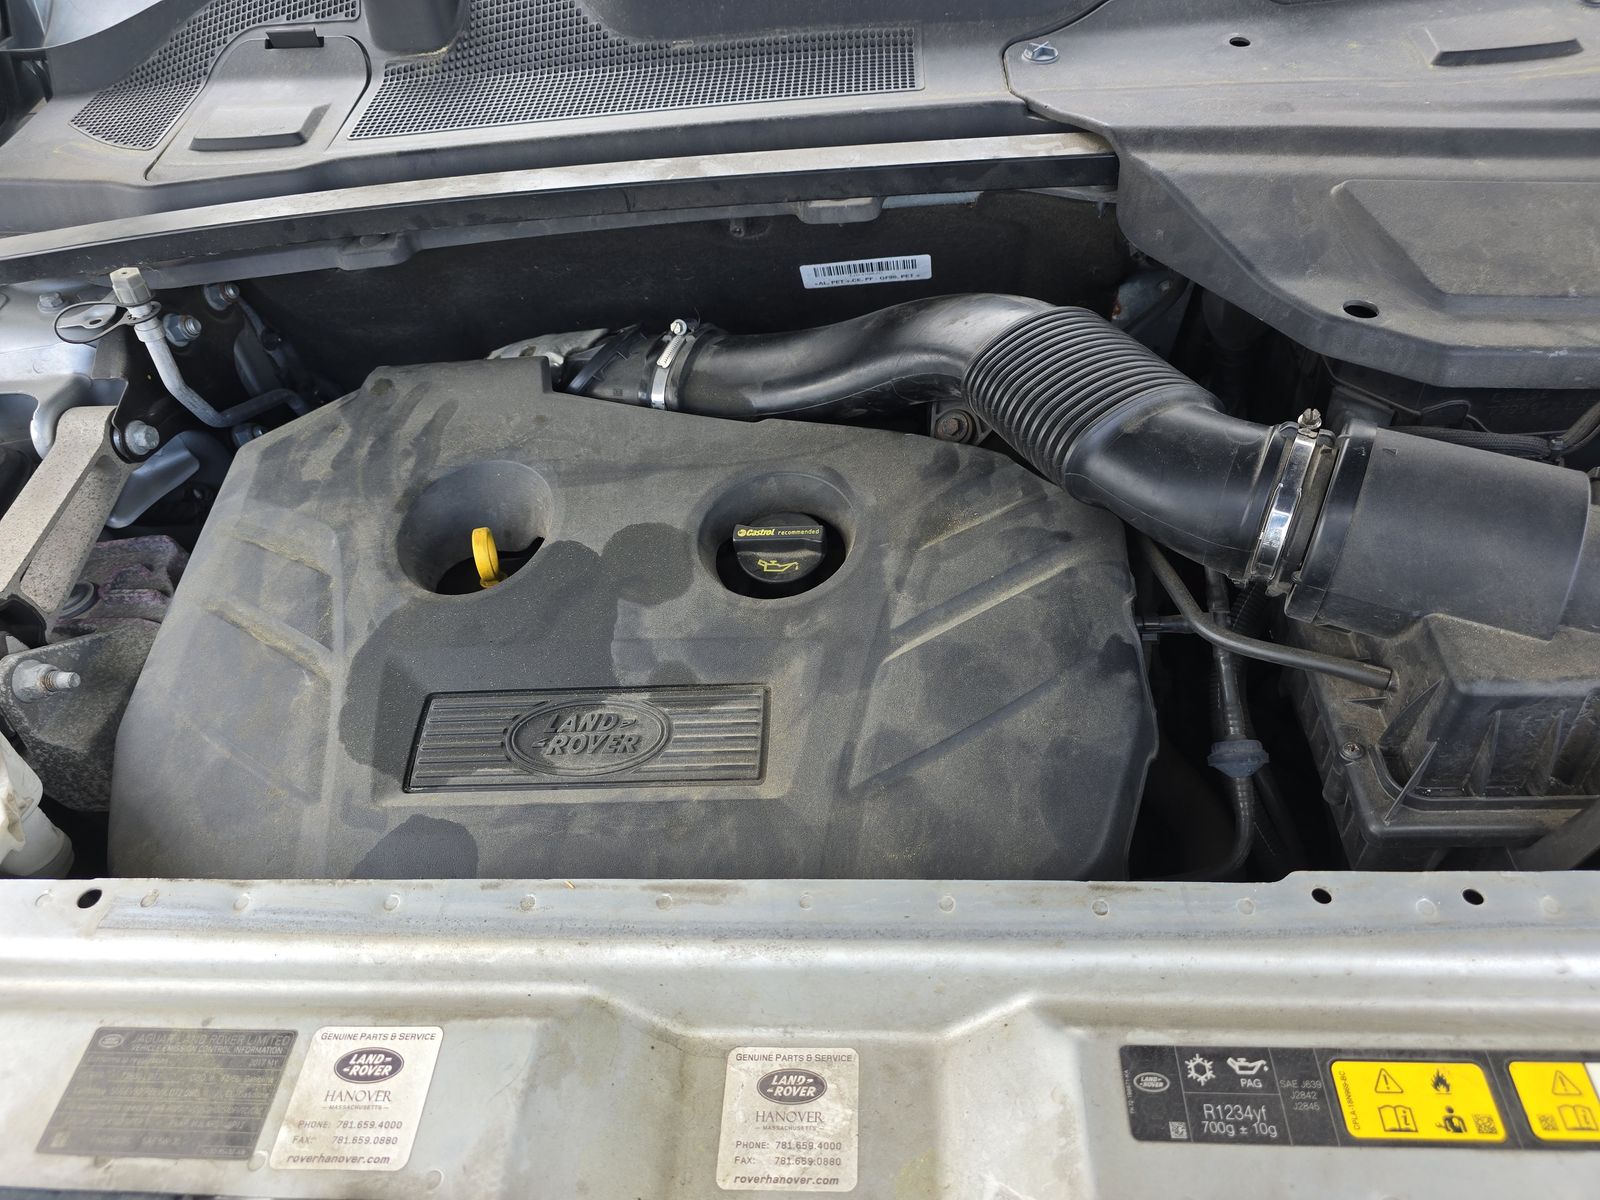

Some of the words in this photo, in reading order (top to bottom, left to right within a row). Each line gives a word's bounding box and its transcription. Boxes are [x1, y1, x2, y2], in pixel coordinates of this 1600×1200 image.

[746, 528, 776, 537] Castrol
[777, 528, 820, 536] recommended
[208, 1033, 245, 1045] ROVER
[246, 1034, 291, 1046] LIMITED
[320, 1032, 359, 1041] GENUINE
[359, 1032, 389, 1041] PARTS
[390, 1032, 397, 1040] &
[398, 1032, 437, 1041] SERVICE
[198, 1045, 231, 1054] CONTROL
[233, 1045, 283, 1055] INFORMATION
[735, 1053, 773, 1062] GENUINE
[775, 1053, 804, 1062] PARTS
[807, 1054, 813, 1062] &
[814, 1053, 853, 1062] SERVICE
[1240, 1078, 1263, 1088] PAG
[1279, 1079, 1298, 1089] SAE
[324, 1089, 392, 1103] HANOVER
[1290, 1090, 1317, 1101] J2842
[755, 1110, 824, 1123] HANOVER
[1203, 1103, 1268, 1123] R1234yf
[297, 1120, 330, 1129] PHONE:
[336, 1120, 403, 1130] 781.659.4000
[1201, 1120, 1236, 1137] 700g
[1253, 1122, 1278, 1138] 10g
[332, 1135, 398, 1145] 781.659.0880
[735, 1140, 770, 1149] PHONE:
[775, 1141, 842, 1150] 781.659.4000
[286, 1154, 391, 1165] roverhanover.com
[734, 1156, 756, 1165] FAX:
[775, 1156, 842, 1166] 781.659.0880
[733, 1175, 839, 1185] roverhanover.com
